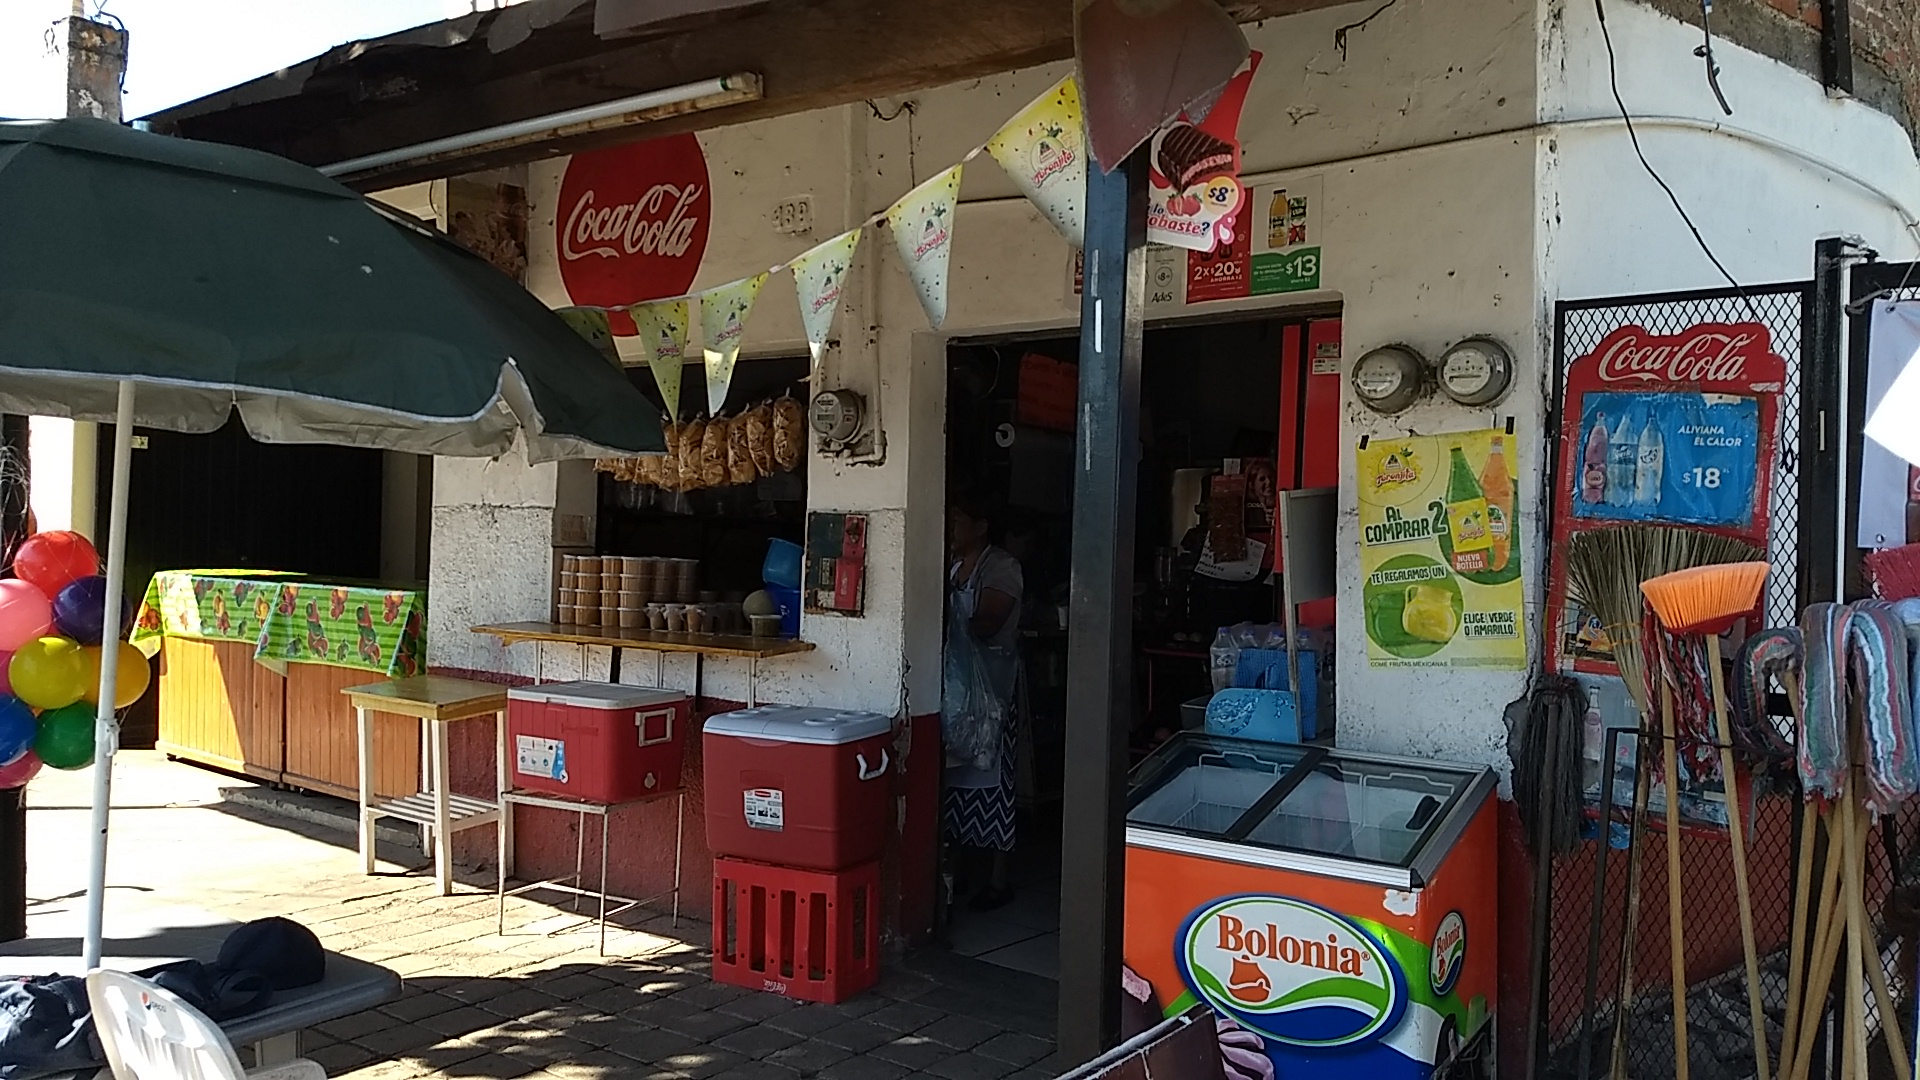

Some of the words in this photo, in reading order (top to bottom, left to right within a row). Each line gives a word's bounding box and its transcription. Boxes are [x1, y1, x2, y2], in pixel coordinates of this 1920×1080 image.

[563, 184, 703, 260] Coca-Cola
[1147, 215, 1211, 236] obaste?
[1285, 255, 1317, 278] $13
[1598, 333, 1757, 382] Coca-Cola
[1678, 425, 1725, 435] ALIVIANA
[1694, 437, 1706, 446] EL
[1706, 437, 1742, 447] CALOR
[1682, 467, 1720, 489] $18
[1385, 506, 1403, 523] AL
[1365, 517, 1431, 543] COMPRAR
[1456, 560, 1484, 570] BOTELLA
[1457, 554, 1480, 562] NUEVA
[1371, 573, 1381, 584] TE
[1384, 568, 1429, 582] REGALAMOS
[1432, 566, 1445, 577] UN
[1463, 612, 1485, 624] ELIGE
[1487, 611, 1514, 623] VERDE
[1464, 625, 1470, 636] O
[1216, 913, 1364, 977] Bolonia
